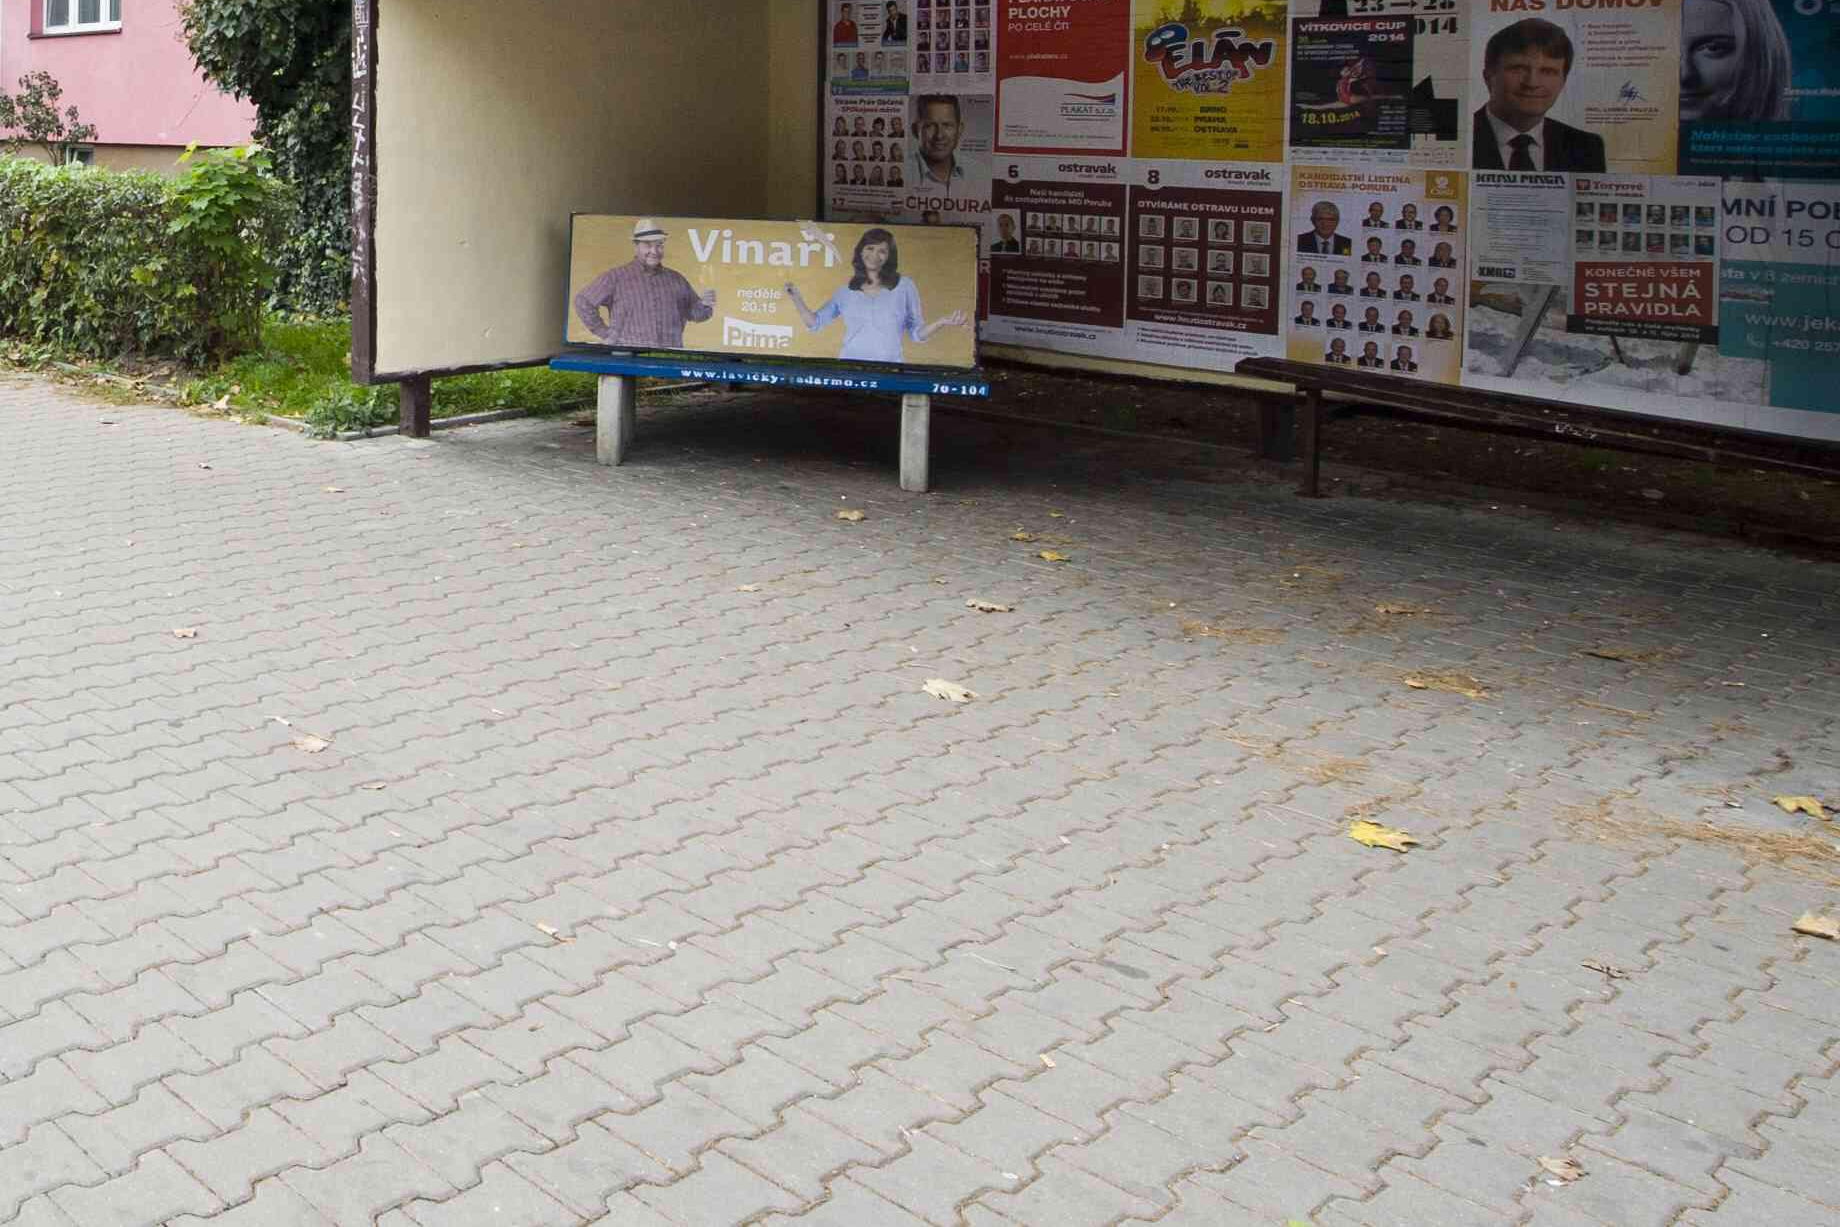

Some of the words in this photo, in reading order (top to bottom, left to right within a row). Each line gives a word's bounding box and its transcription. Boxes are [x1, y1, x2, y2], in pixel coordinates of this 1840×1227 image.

[1008, 5, 1072, 20] PLOCHY
[1375, 20, 1406, 31] CUP
[1367, 33, 1406, 42] 2014
[1007, 165, 1019, 179] 6
[1058, 163, 1117, 174] ostravak
[1147, 169, 1160, 184] 8
[1204, 168, 1271, 181] ostravak
[1591, 181, 1645, 192] Toryové
[905, 196, 993, 214] CHODURA
[1137, 199, 1190, 211] OTVÍRÁME
[1191, 202, 1239, 214] OSTRAVU
[1240, 204, 1275, 215] LIDEM
[1726, 225, 1771, 245] OD
[1782, 228, 1816, 248] 15
[687, 224, 837, 269] Vinaři
[1585, 267, 1657, 278] KONEČNĚ
[1659, 266, 1702, 278] VŠEM
[1584, 280, 1702, 299] STEJNÁ
[1584, 302, 1702, 317] PRAVIDLA
[727, 320, 792, 350] Prima
[931, 382, 988, 398] 70-104
